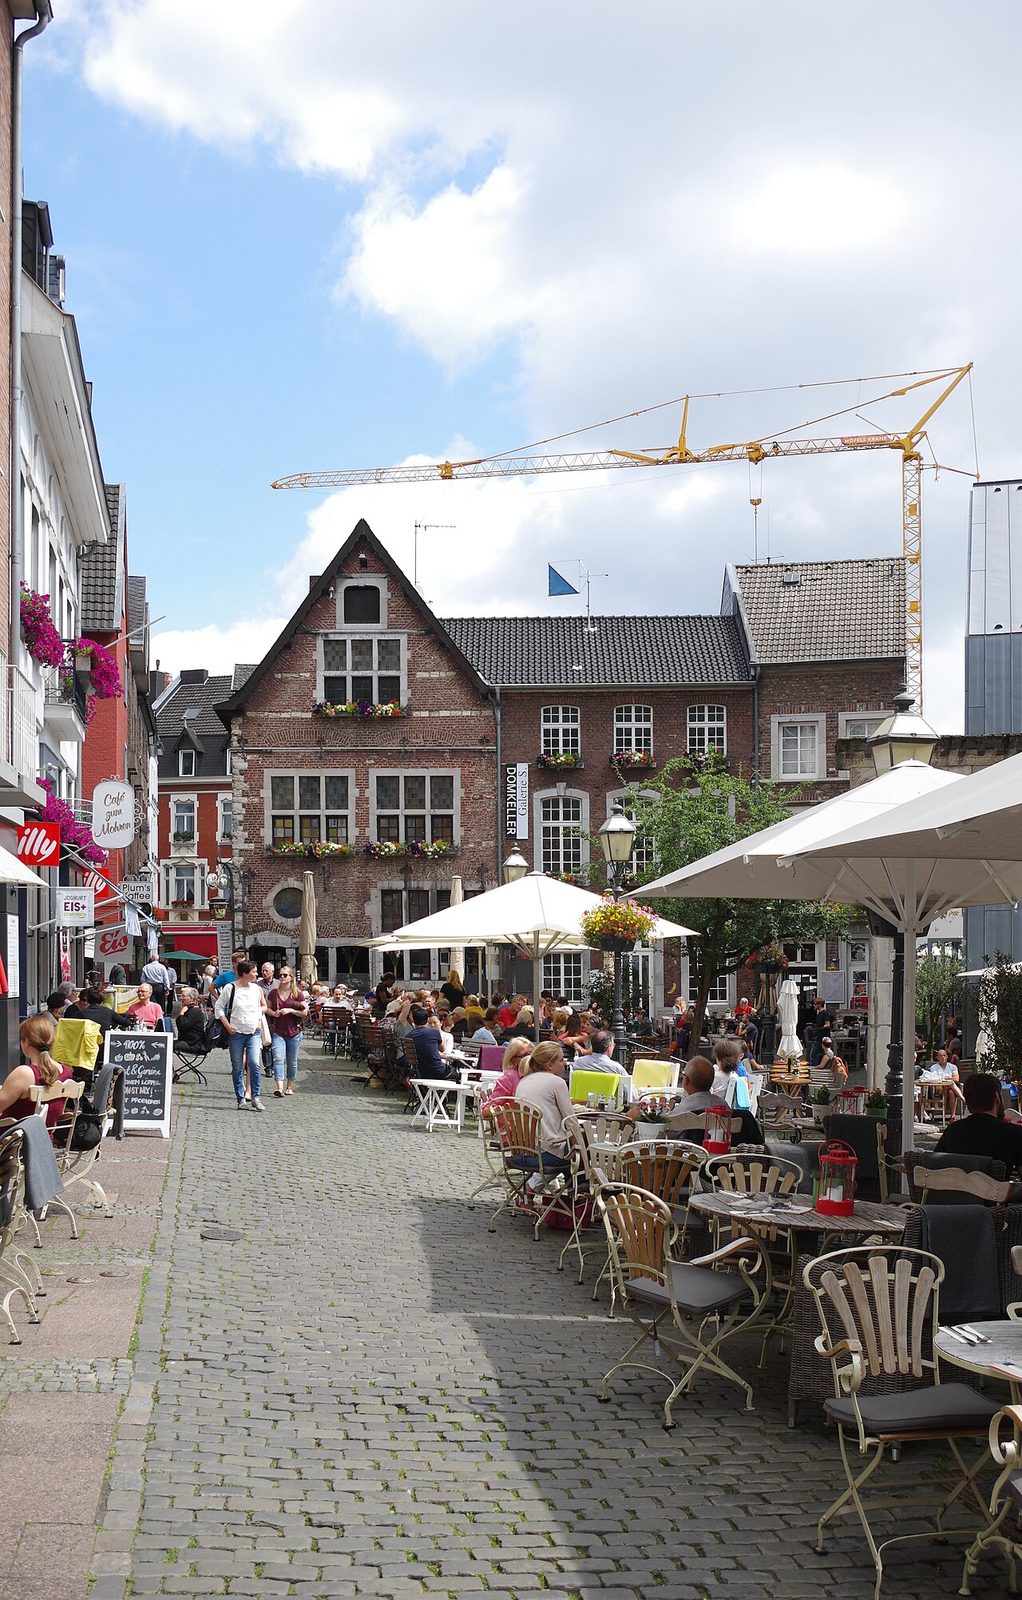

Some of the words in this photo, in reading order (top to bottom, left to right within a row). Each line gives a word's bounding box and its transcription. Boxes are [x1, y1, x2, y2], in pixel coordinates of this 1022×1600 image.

[103, 791, 126, 806] Café
[506, 767, 517, 835] DOMKELLER
[518, 781, 527, 816] Galerie
[105, 808, 123, 822] zum
[94, 821, 131, 838] Mohren
[17, 827, 57, 863] illy
[83, 871, 107, 896] illy
[122, 883, 151, 892] Plum's
[63, 902, 87, 912] EIS+
[99, 929, 129, 955] Eis
[123, 1040, 146, 1050] 100%
